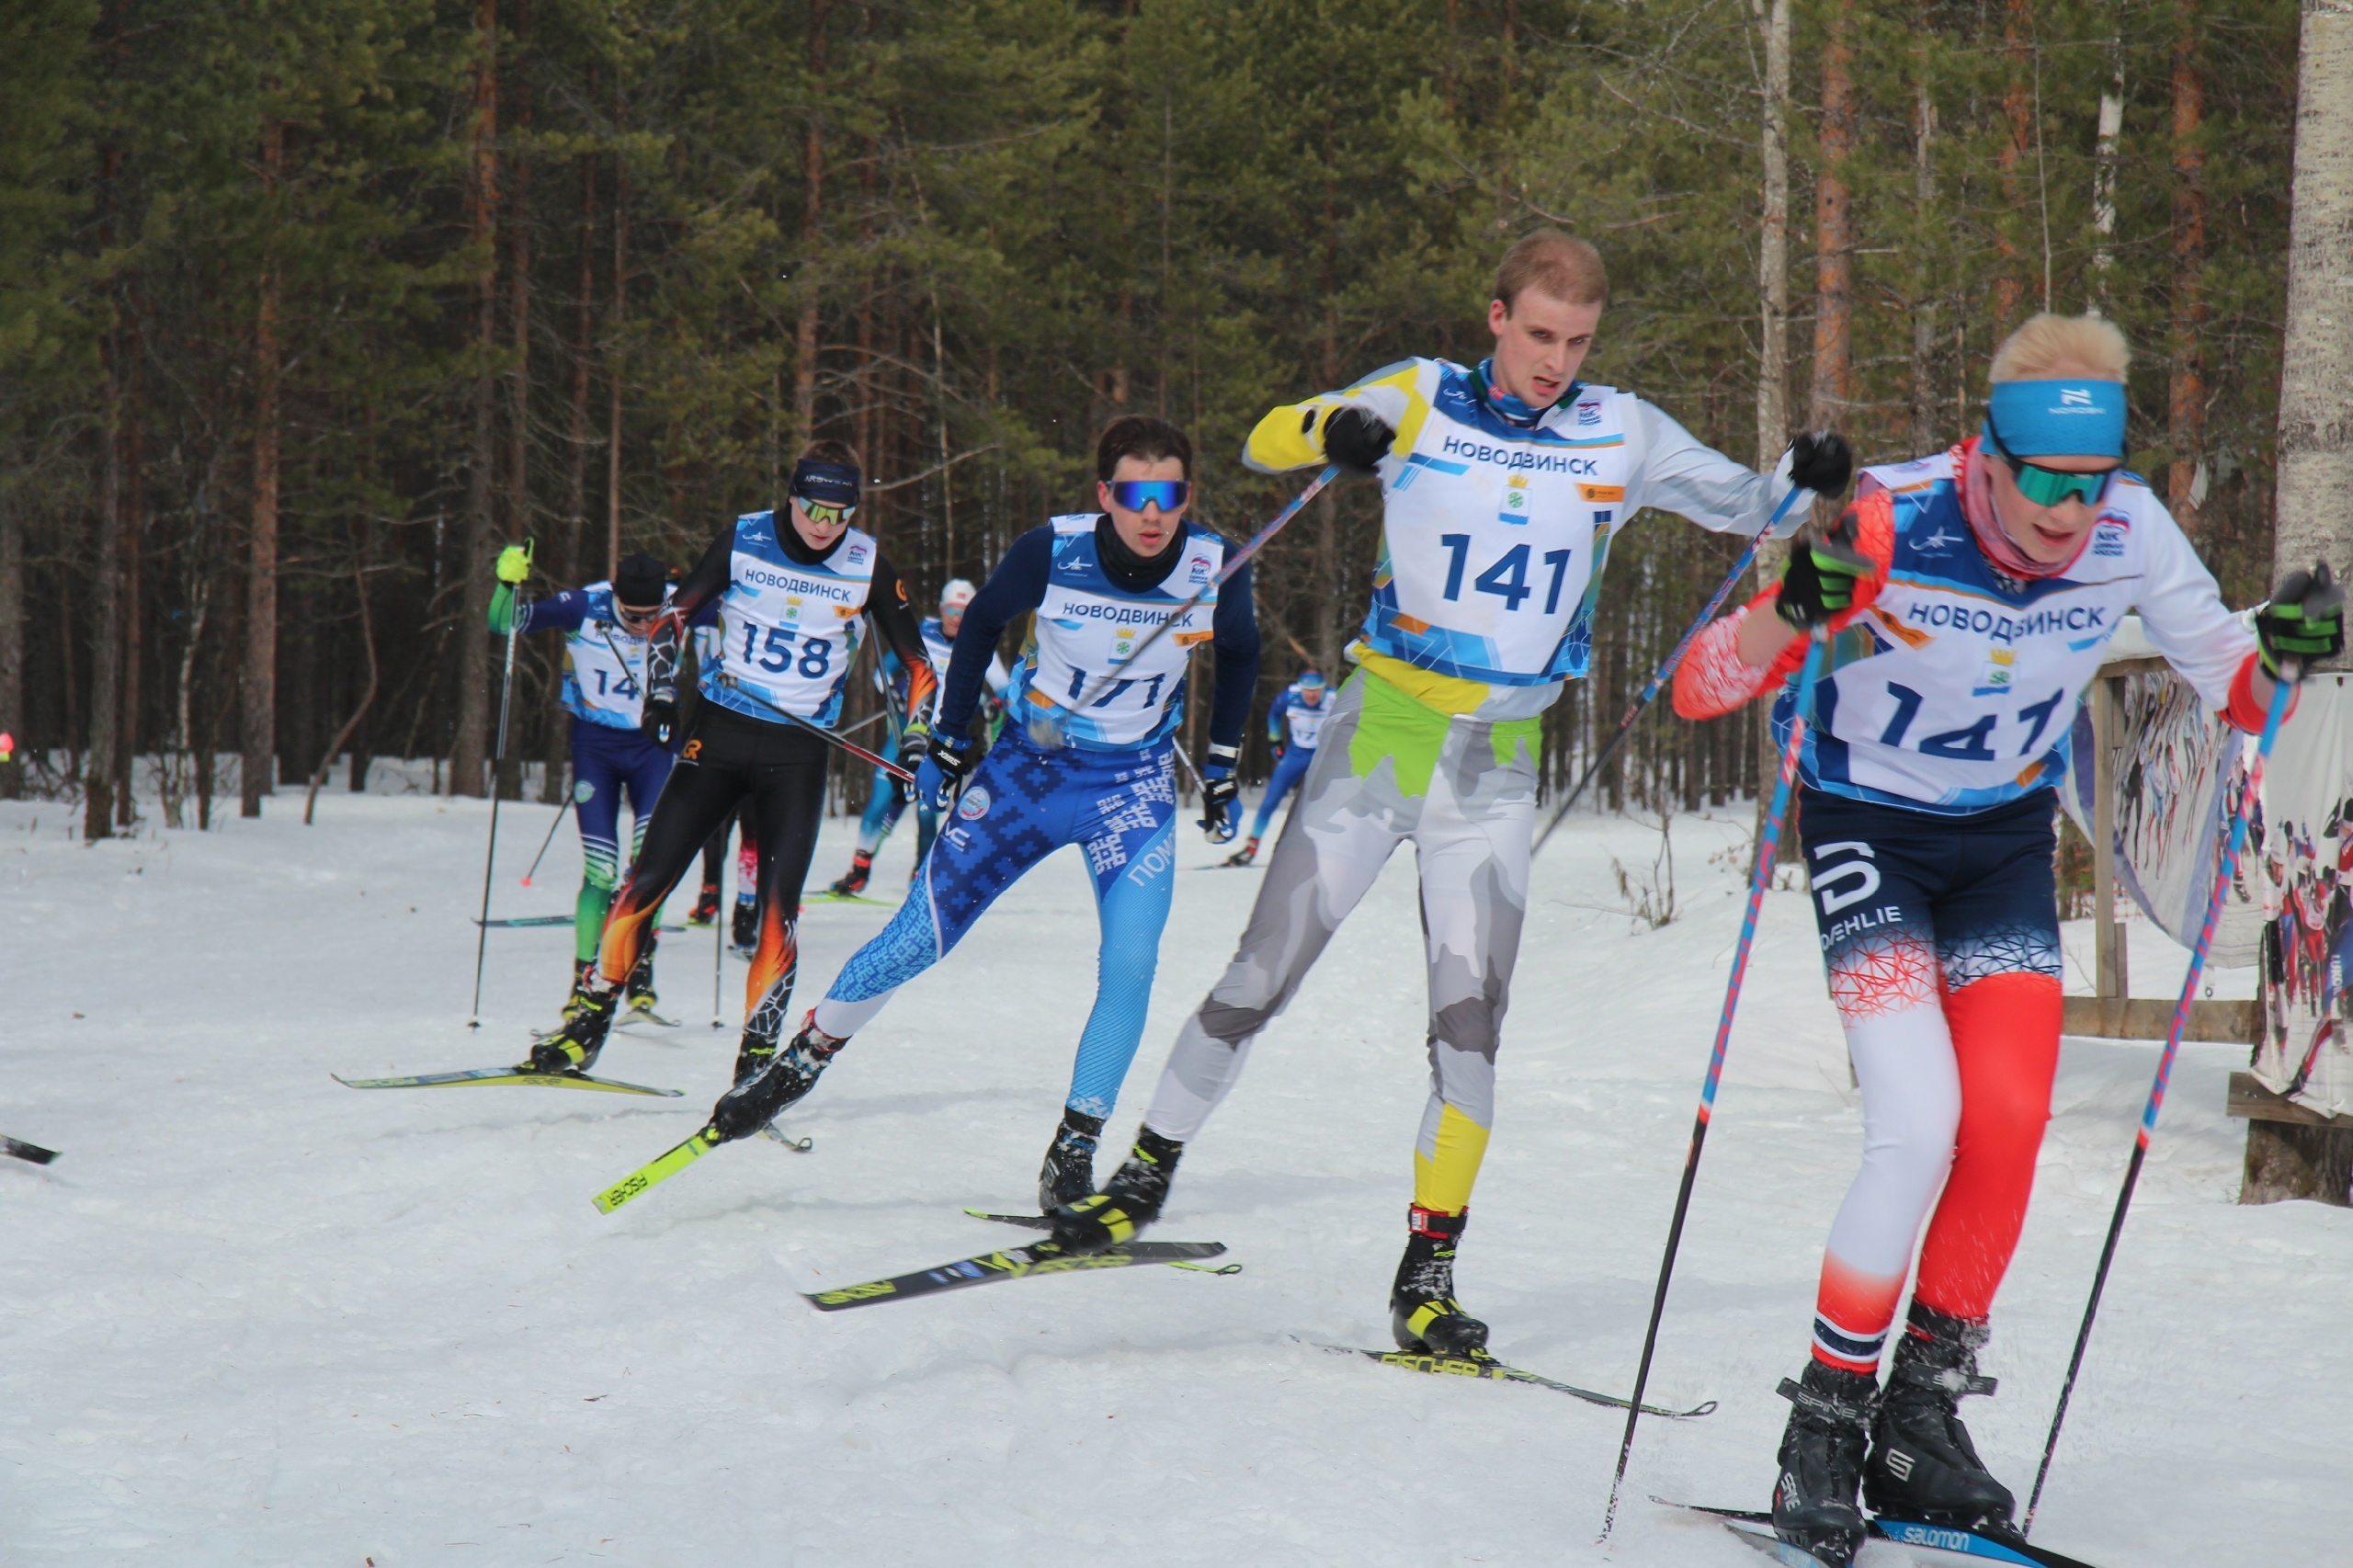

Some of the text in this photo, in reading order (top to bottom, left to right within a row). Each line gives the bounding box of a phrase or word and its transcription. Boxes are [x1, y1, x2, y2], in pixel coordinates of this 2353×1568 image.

[1443, 436, 1598, 476] НОВОДВИНСК
[745, 569, 851, 603] НОВОДВИНСК
[1440, 533, 1572, 615] 141
[1063, 603, 1194, 627] НОВОДВИНК
[743, 621, 832, 679] 158
[594, 668, 640, 700] 14
[1067, 664, 1165, 709] 171
[1127, 824, 1176, 886] ПОМ
[607, 1174, 648, 1206] FISCHER
[1797, 1392, 1857, 1419] SPINE
[1903, 1527, 1970, 1551] salomon
